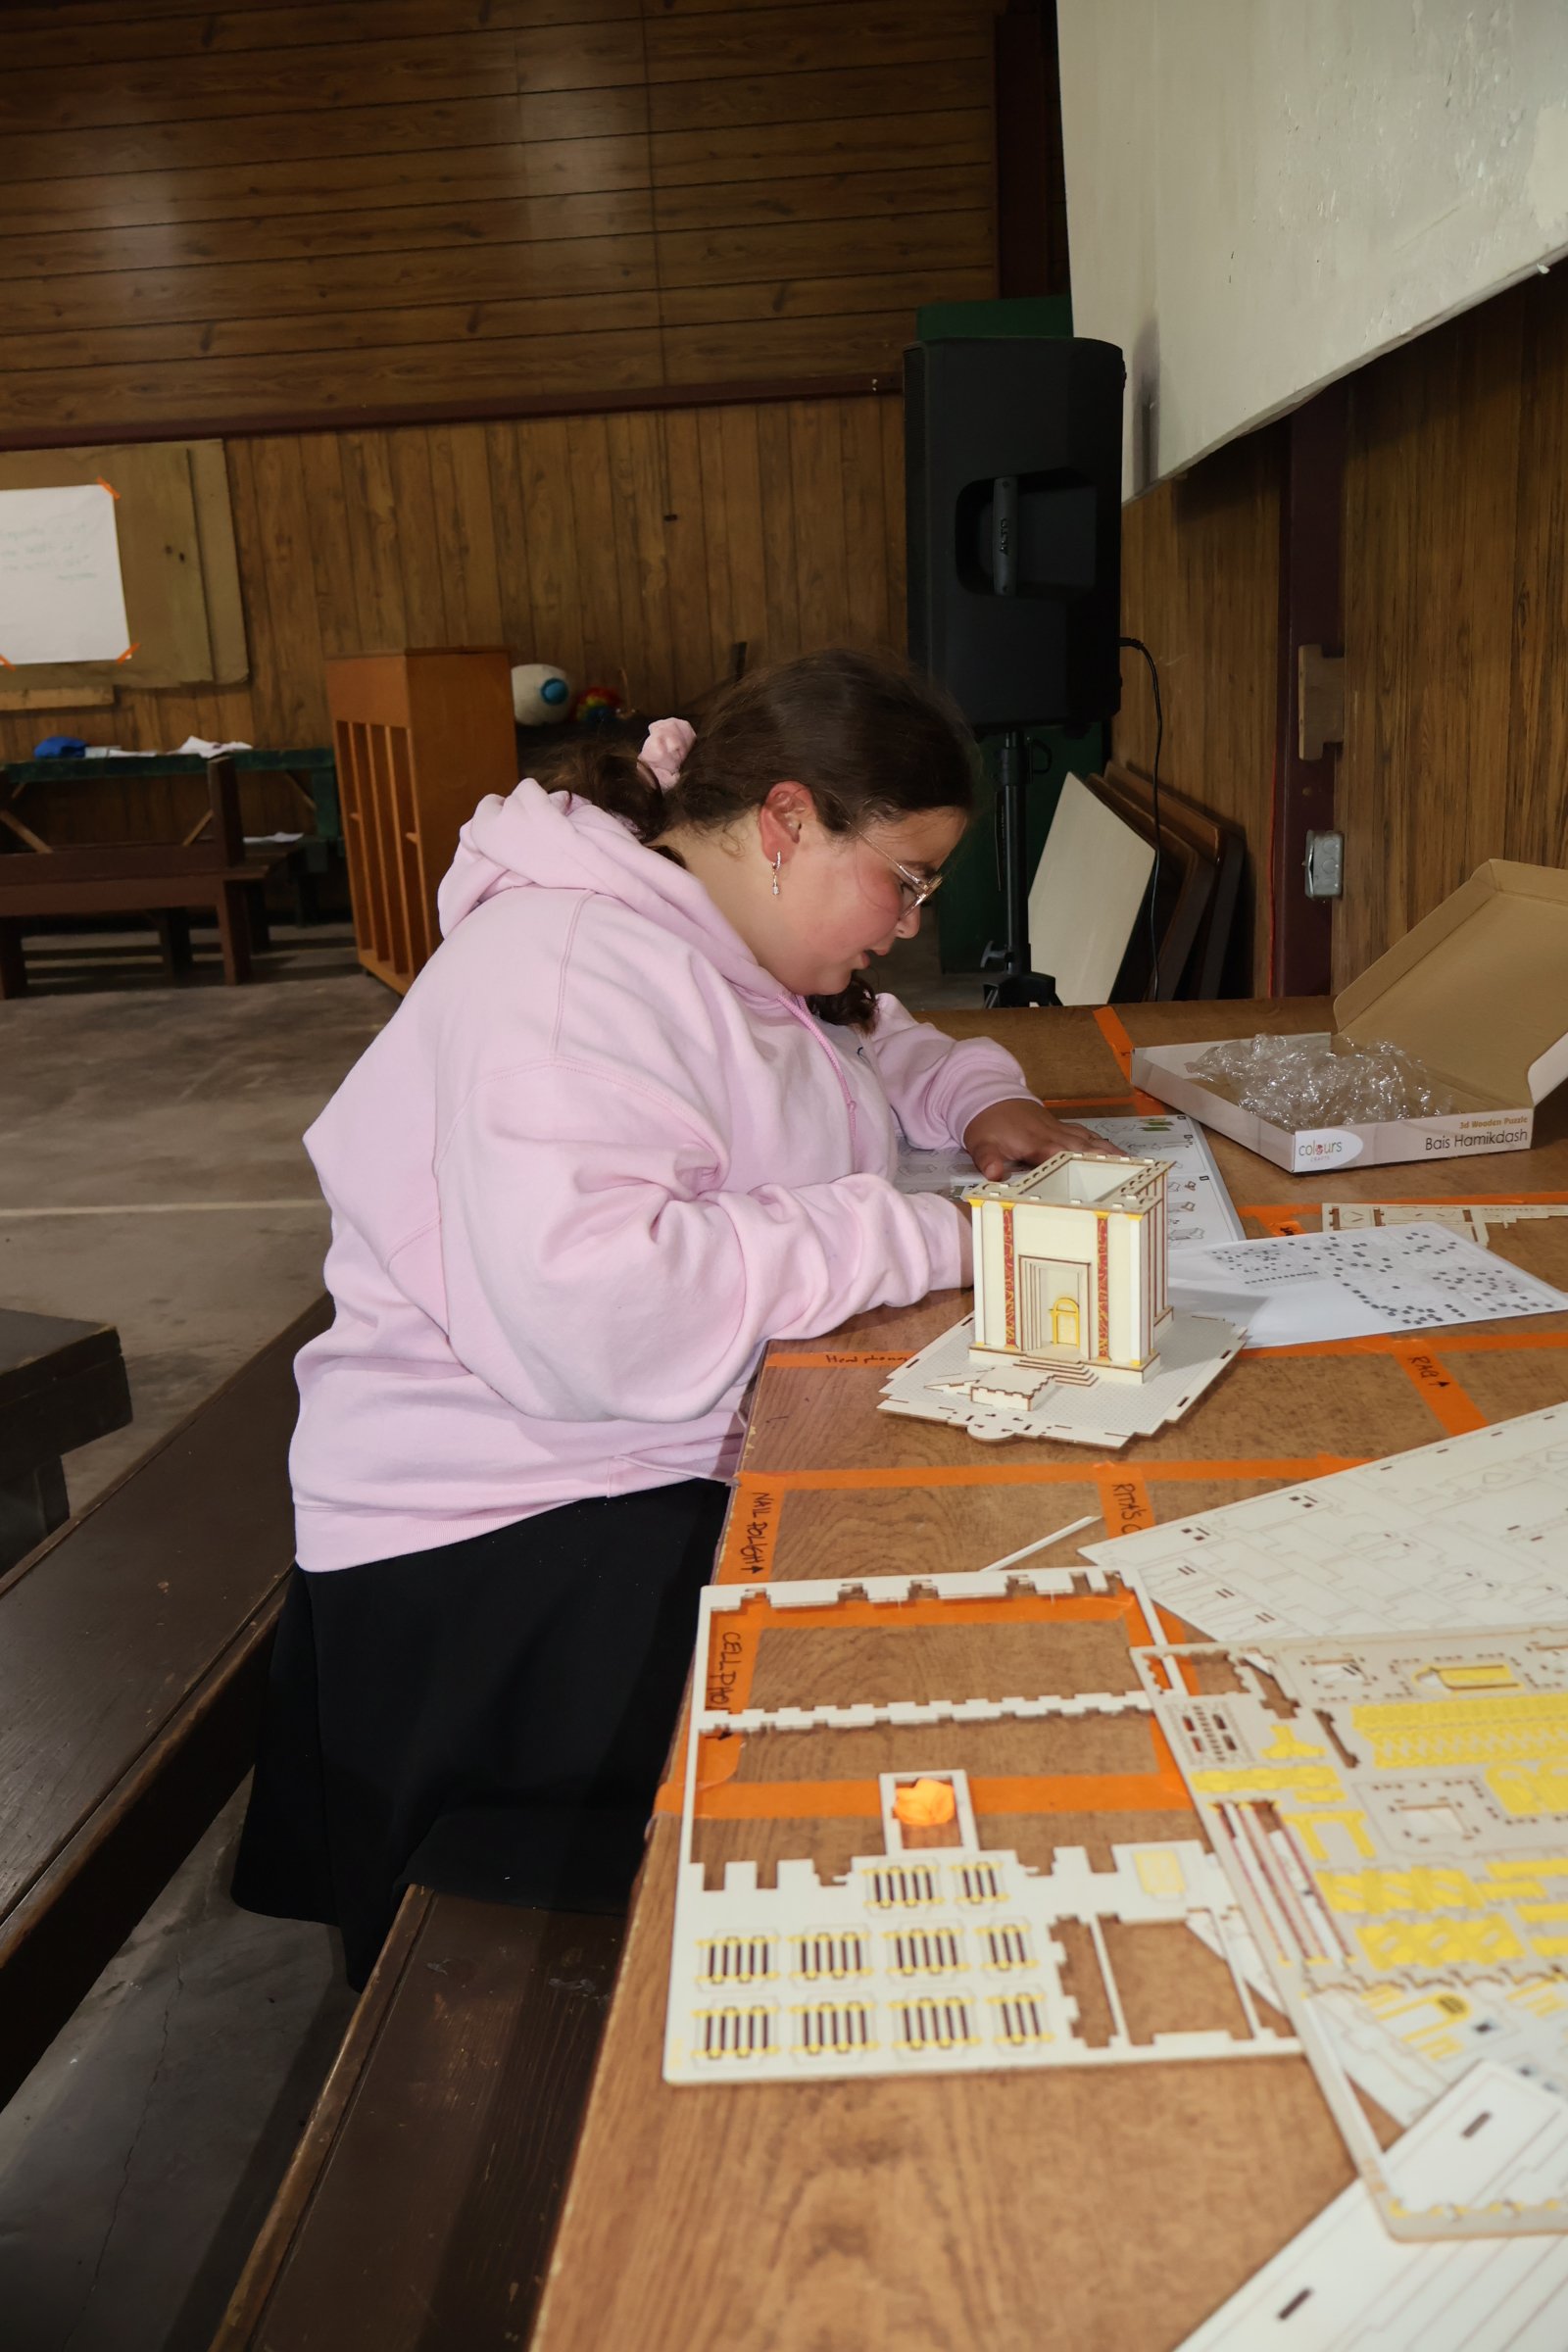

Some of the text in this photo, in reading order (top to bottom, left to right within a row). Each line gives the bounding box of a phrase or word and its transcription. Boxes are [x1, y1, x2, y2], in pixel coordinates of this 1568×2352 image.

[1472, 1118, 1502, 1128] Wooden
[1504, 1115, 1529, 1124] Puzzle
[1298, 1139, 1343, 1156] colours
[1425, 1128, 1528, 1151] Bais Hamikdash
[752, 1492, 775, 1519] NAIL
